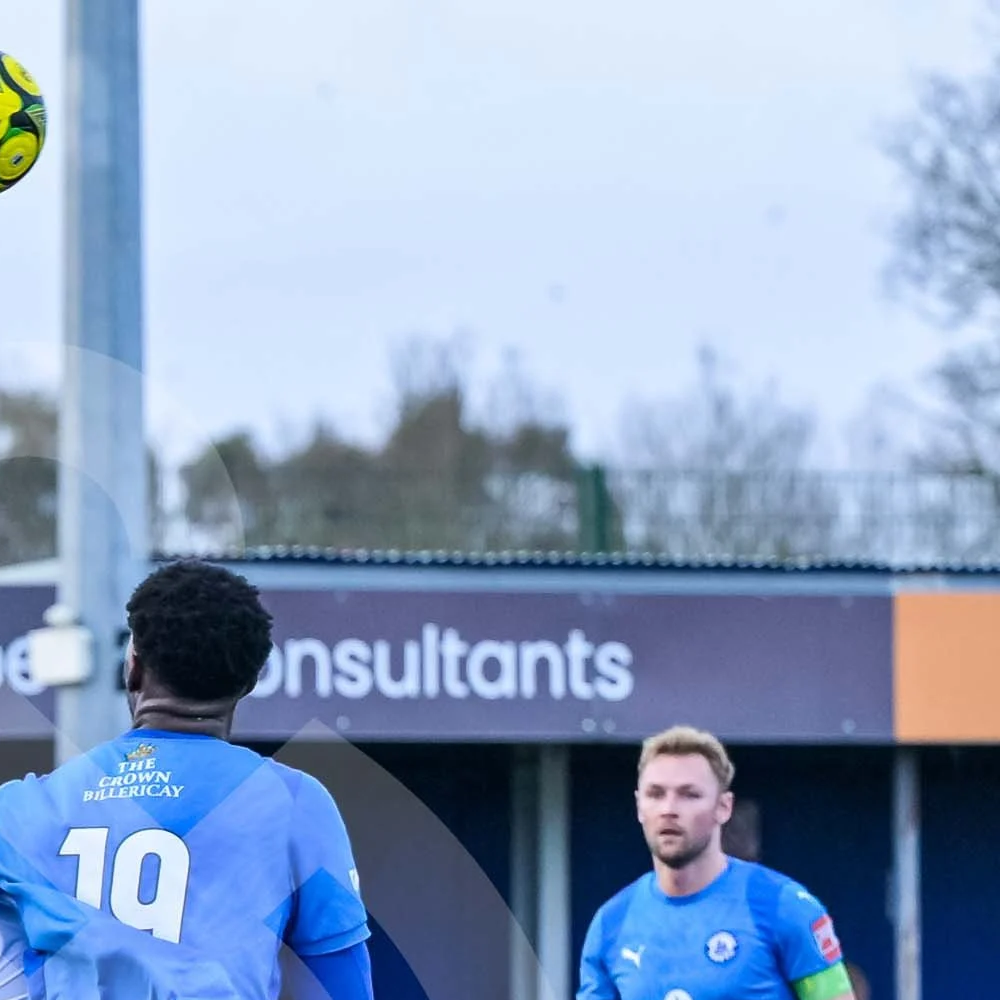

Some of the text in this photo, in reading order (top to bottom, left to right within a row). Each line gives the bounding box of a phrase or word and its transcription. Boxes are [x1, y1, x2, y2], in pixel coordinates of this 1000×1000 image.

[250, 622, 635, 700] onsultants
[118, 757, 156, 774] THE
[99, 771, 173, 788] CROWN
[83, 784, 184, 802] BILLERICAY
[57, 826, 191, 944] 19
